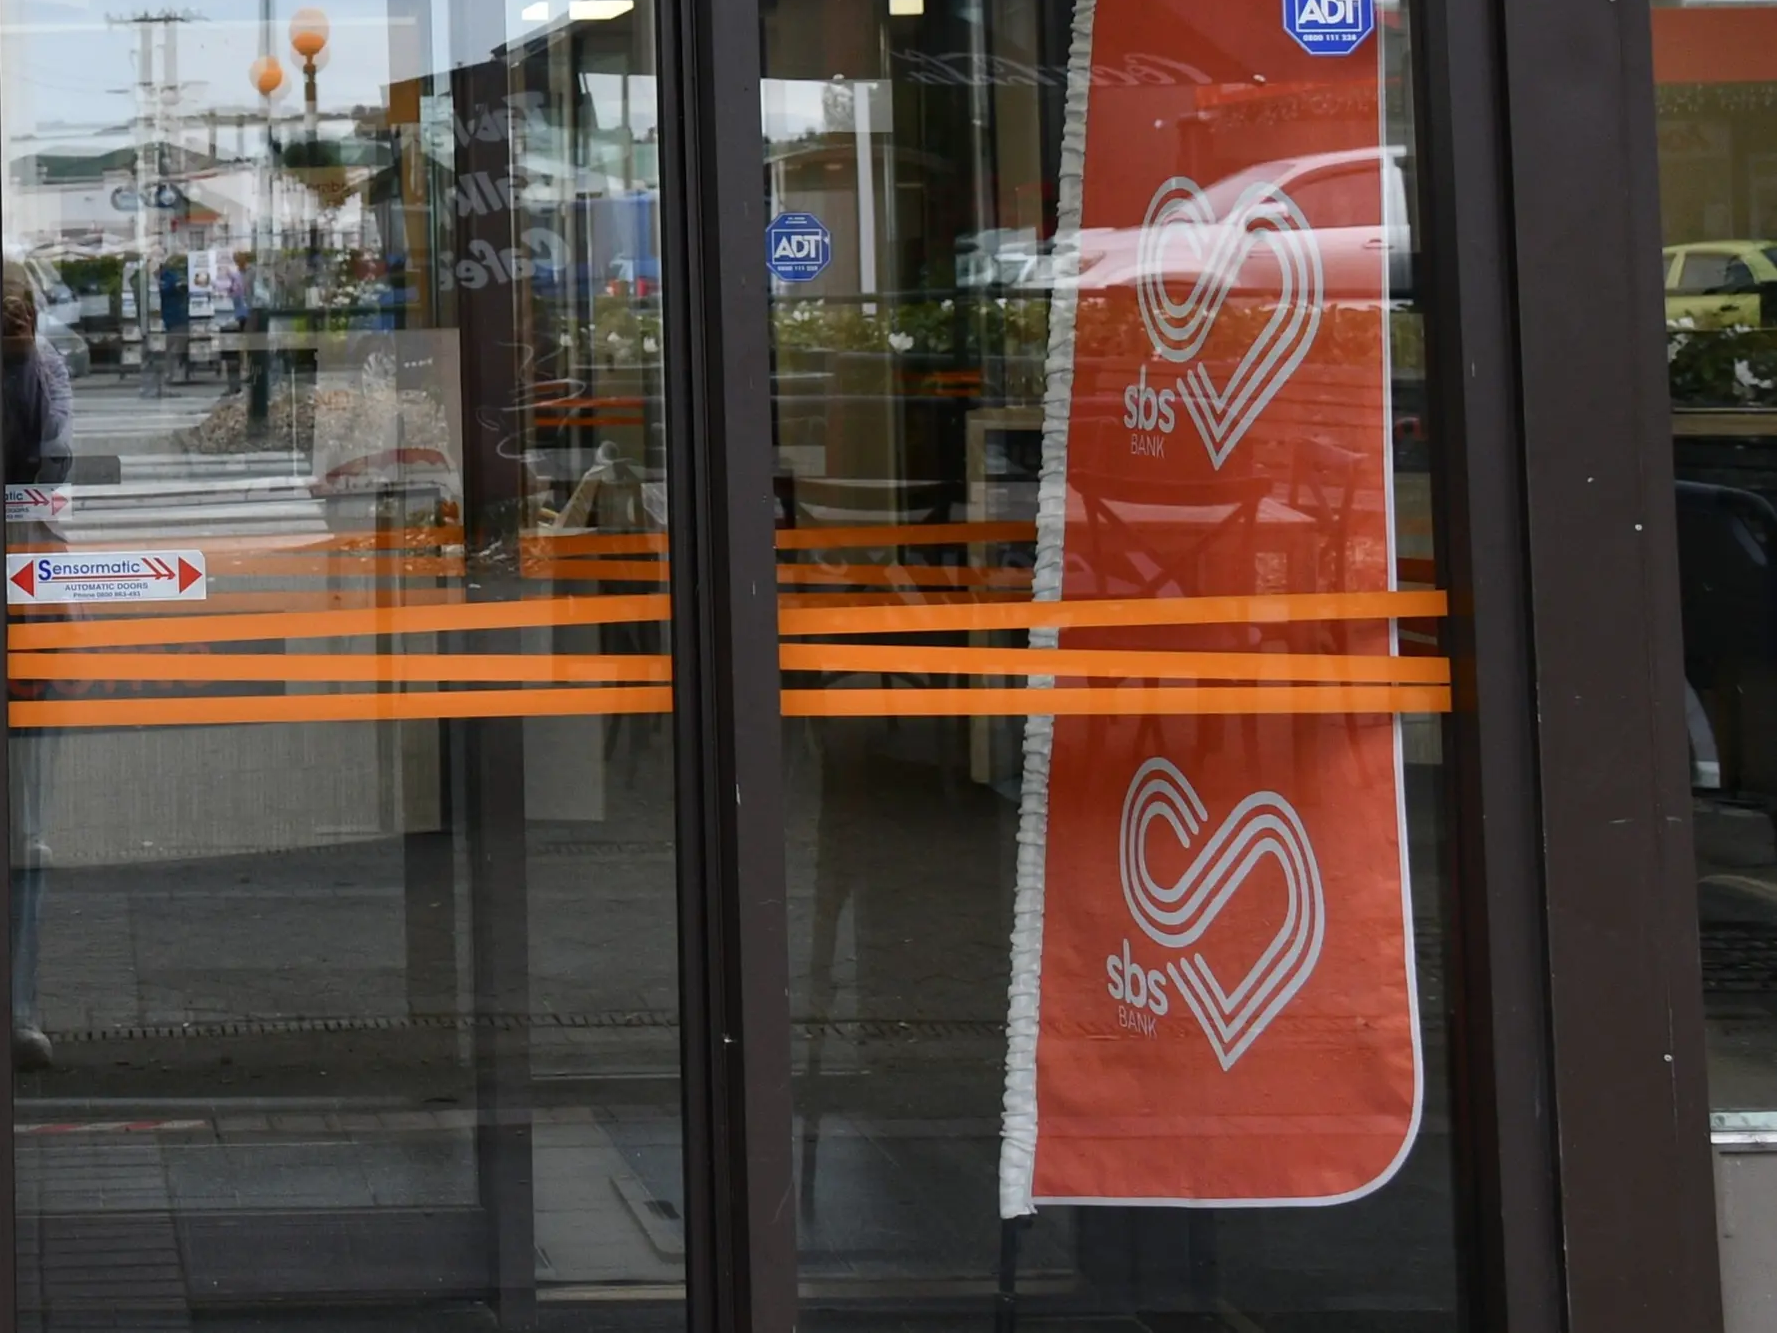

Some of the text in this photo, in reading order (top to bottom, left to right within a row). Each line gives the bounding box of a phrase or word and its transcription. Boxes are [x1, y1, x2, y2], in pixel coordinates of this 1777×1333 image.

[774, 235, 820, 258] ADT
[1124, 364, 1175, 433] sbs
[1131, 433, 1164, 458] BANK
[38, 559, 140, 581] Sensormatic
[65, 582, 149, 591] AUTOMATIC DOORS
[1107, 938, 1168, 1015] sbs
[1118, 1005, 1157, 1037] BANK
